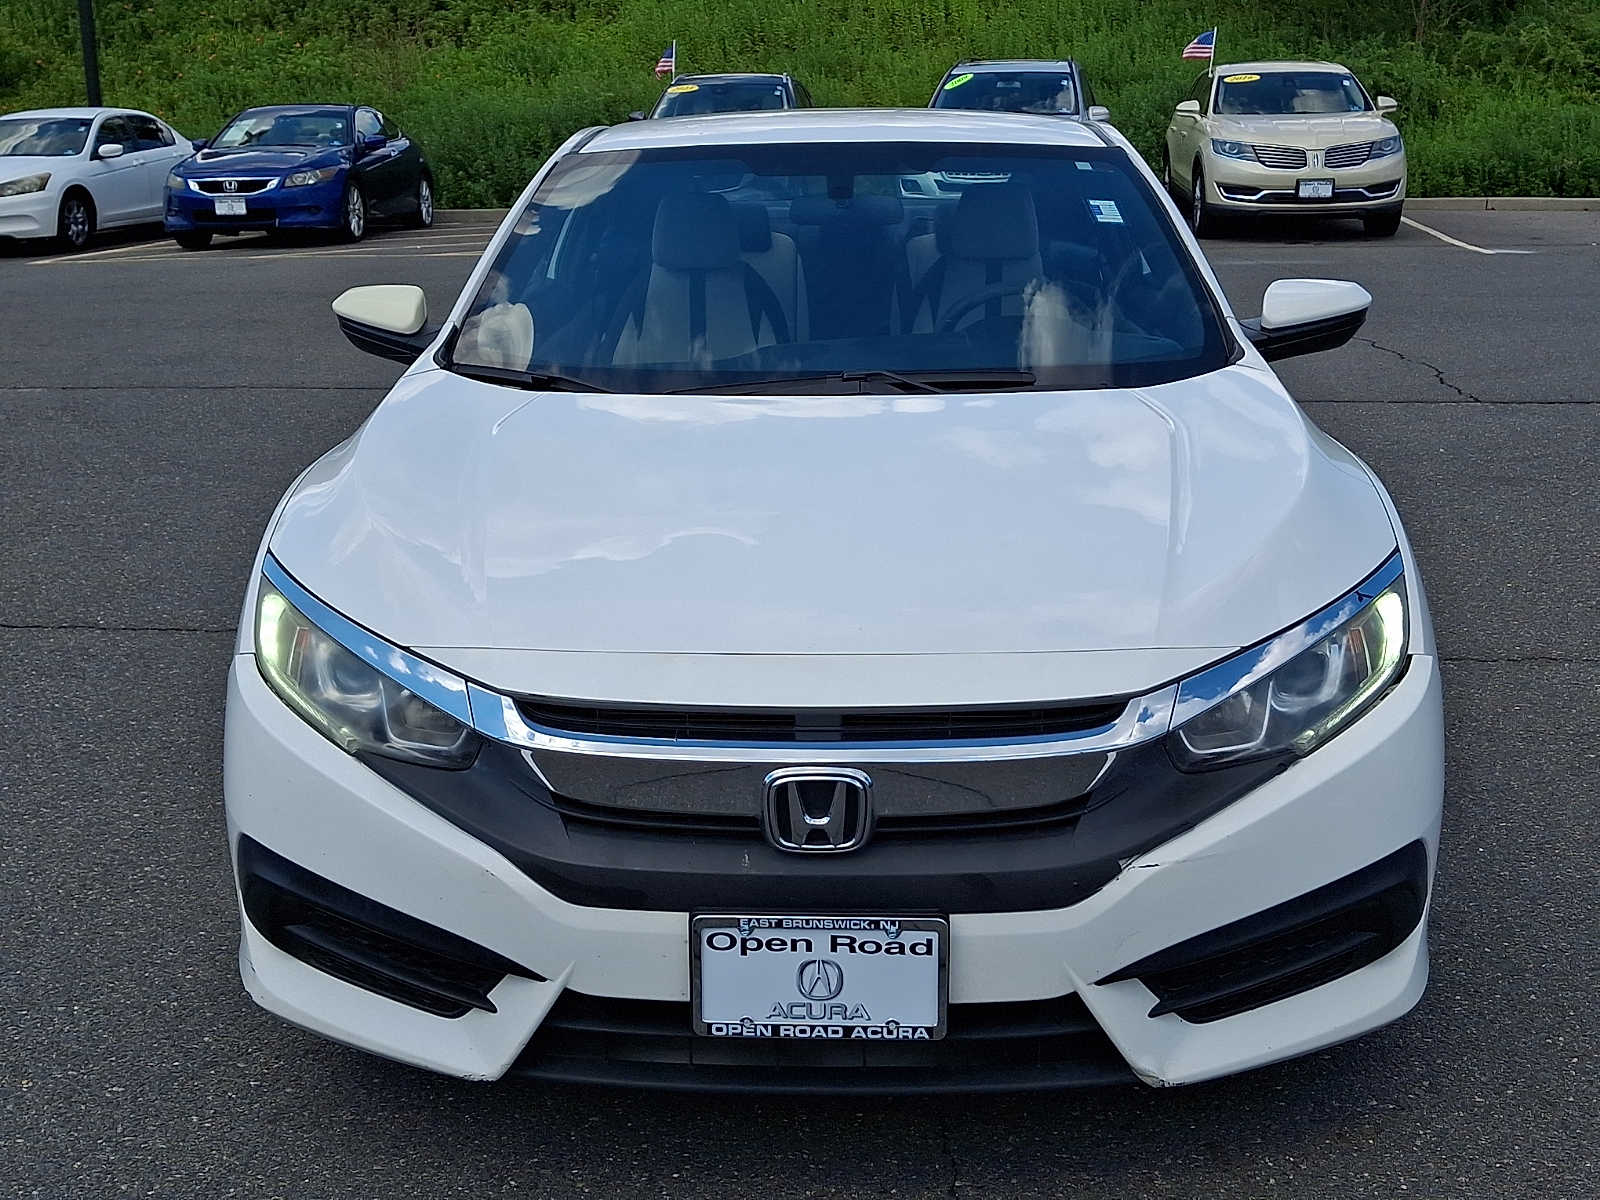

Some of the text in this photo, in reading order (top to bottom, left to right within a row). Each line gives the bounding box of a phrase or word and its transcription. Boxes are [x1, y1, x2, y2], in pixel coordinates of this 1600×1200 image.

[740, 919, 778, 928] EAST
[880, 920, 899, 930] NJ
[706, 932, 934, 957] Open Road
[765, 1001, 872, 1021] ACURA
[711, 1023, 930, 1040] OPEN ROAD ACURA
